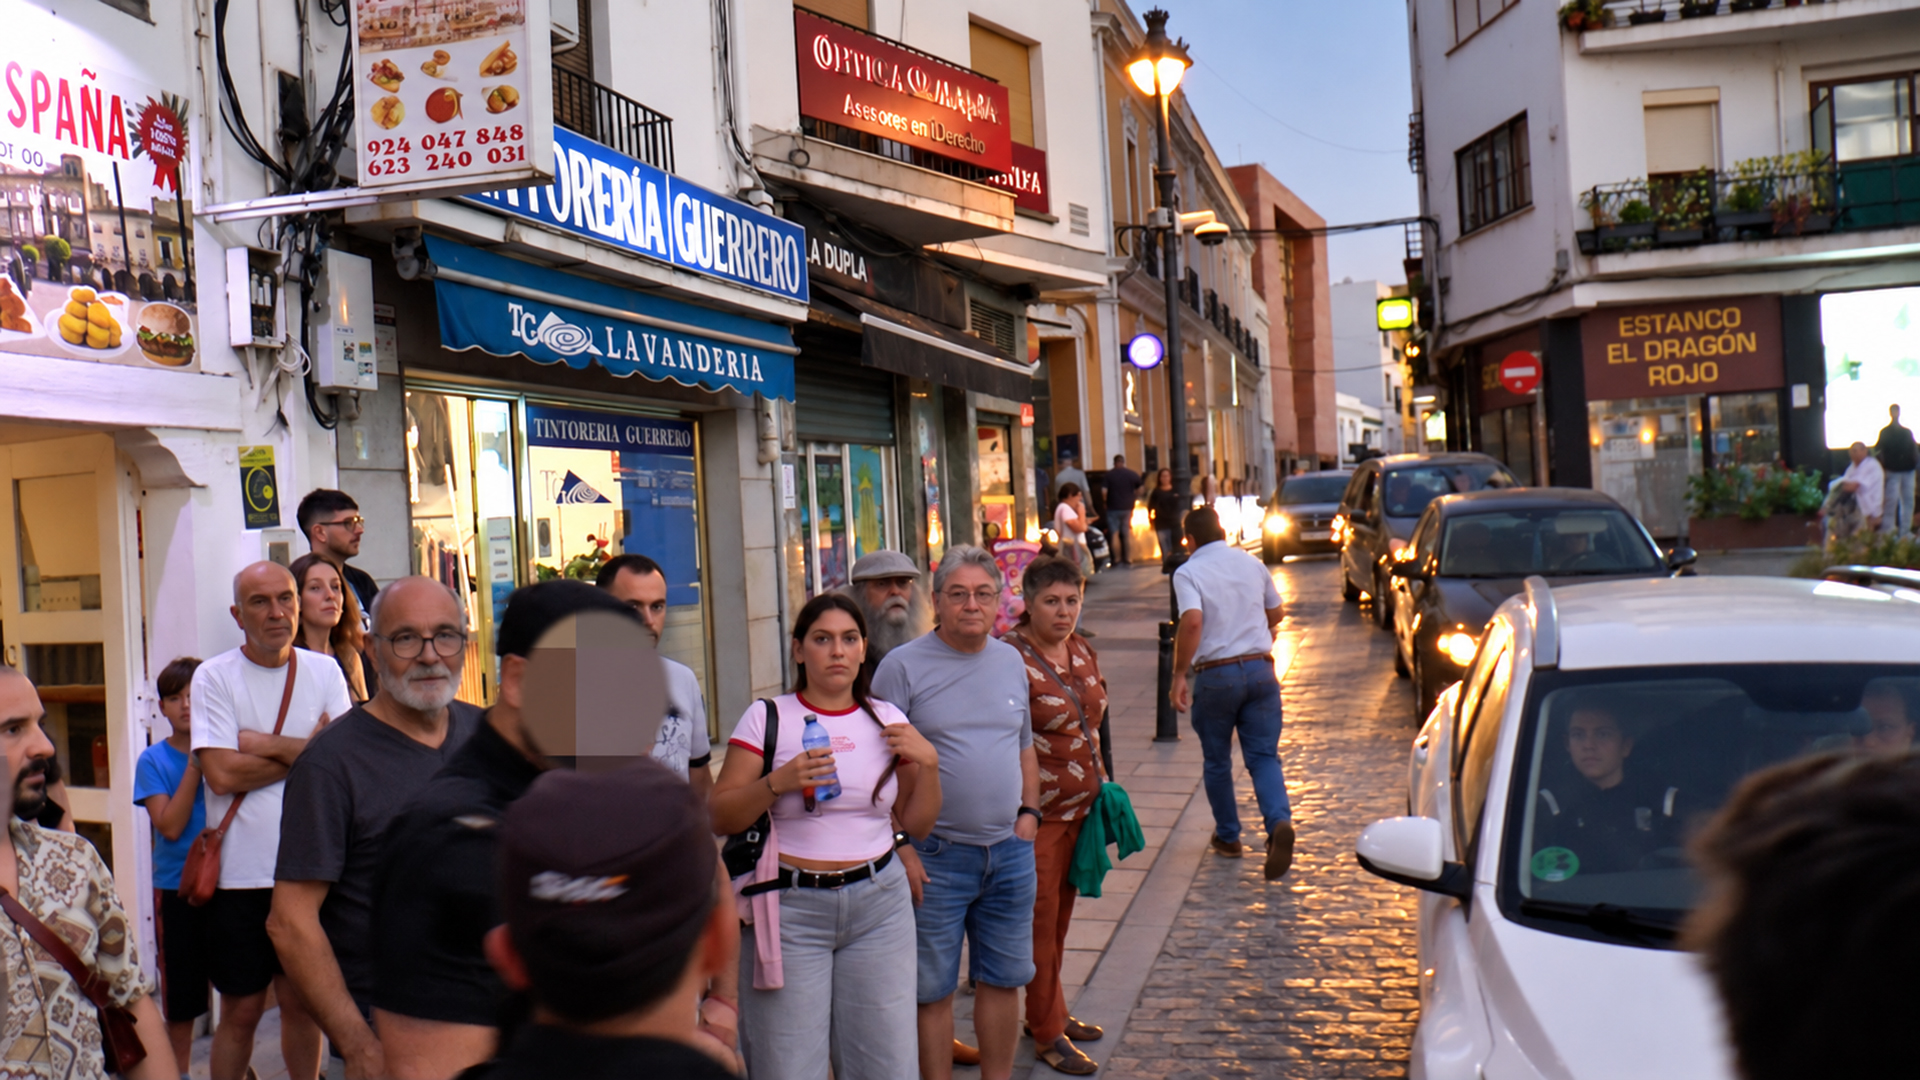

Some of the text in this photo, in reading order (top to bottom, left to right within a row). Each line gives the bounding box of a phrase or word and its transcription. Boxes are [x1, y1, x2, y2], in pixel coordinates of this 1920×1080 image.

[367, 124, 524, 157] 924 047 848
[911, 120, 928, 137] en
[368, 145, 526, 176] 623 240 031
[481, 141, 800, 294] ORERÍA GUERRERO
[806, 237, 868, 283] A DUPLA
[1619, 307, 1742, 337] ESTANCO
[605, 326, 764, 382] LAVANDERIA
[1607, 329, 1757, 364] EL DRAGÓN
[1649, 361, 1719, 387] ROJO
[533, 418, 691, 447] TINTORERIA GUERRERO
